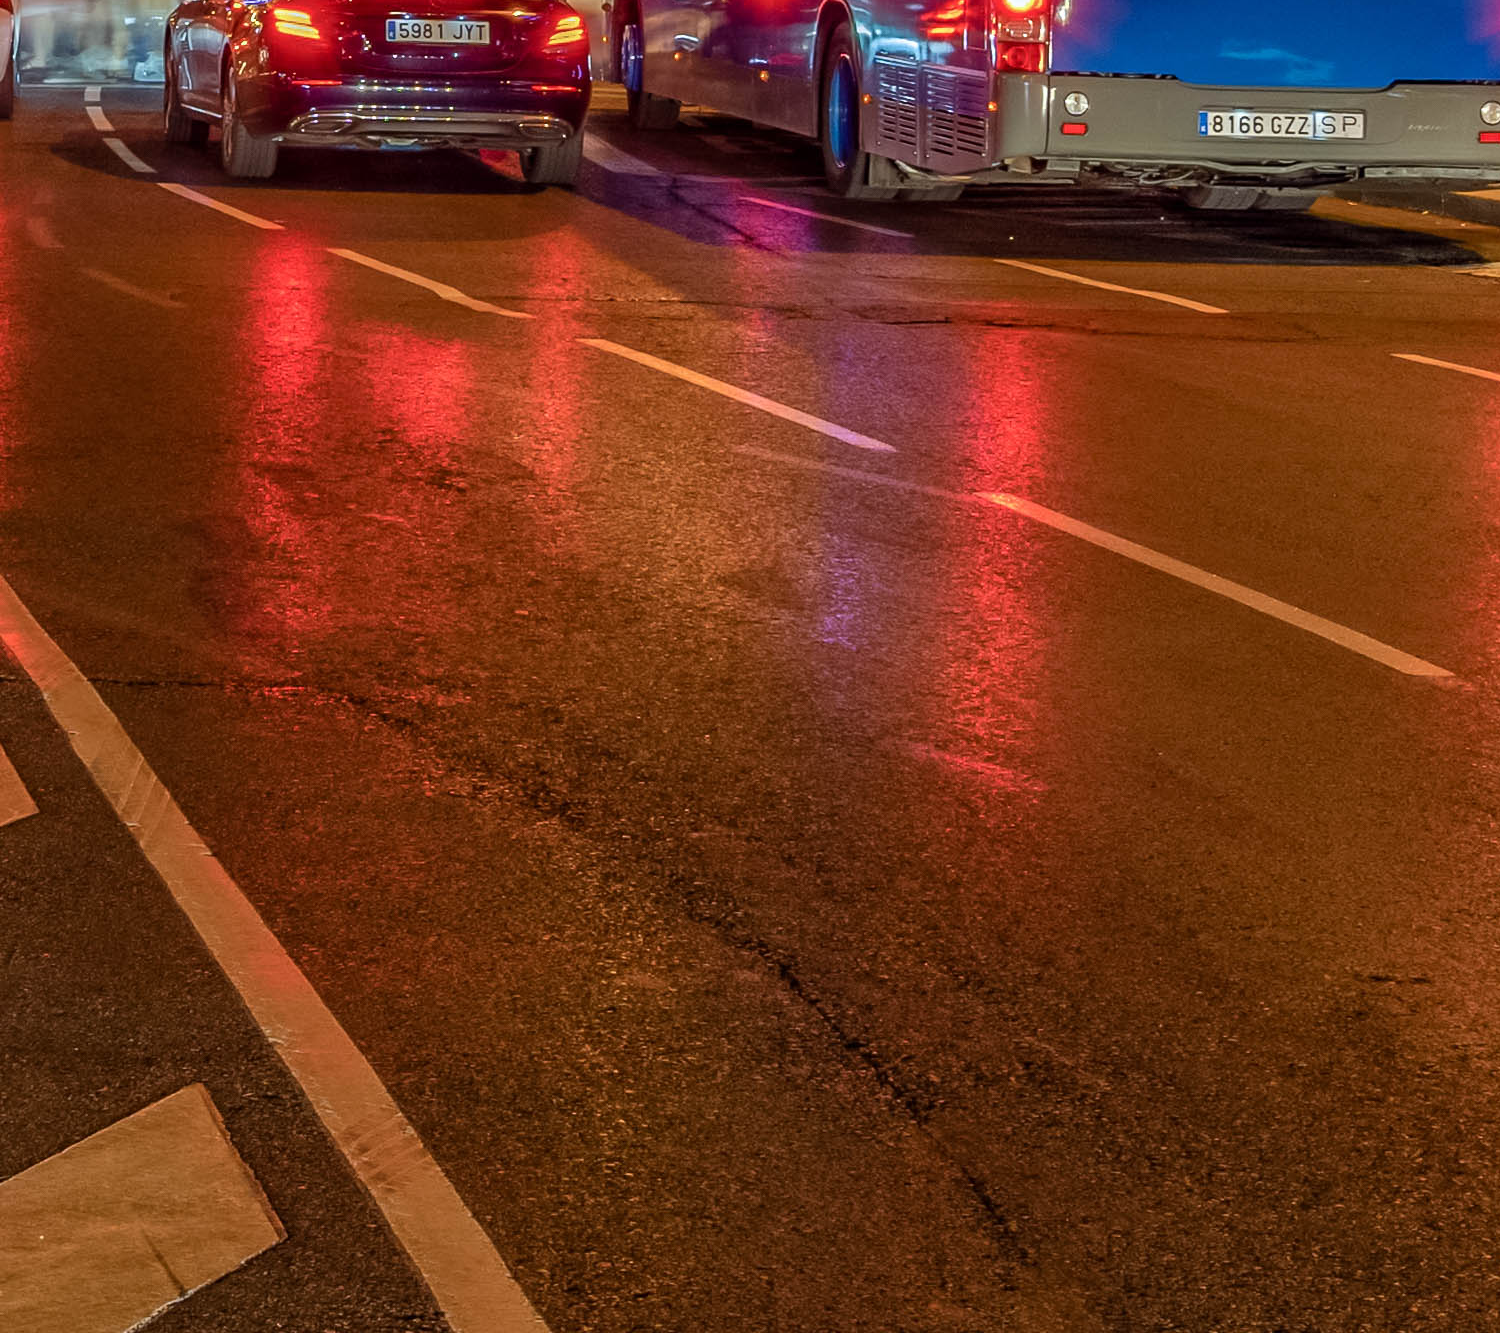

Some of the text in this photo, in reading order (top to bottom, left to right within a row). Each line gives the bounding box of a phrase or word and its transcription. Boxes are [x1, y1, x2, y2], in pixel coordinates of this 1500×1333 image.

[399, 22, 485, 40] 5981 JYT
[1212, 115, 1264, 134] 8166
[1270, 116, 1309, 135] GZZ
